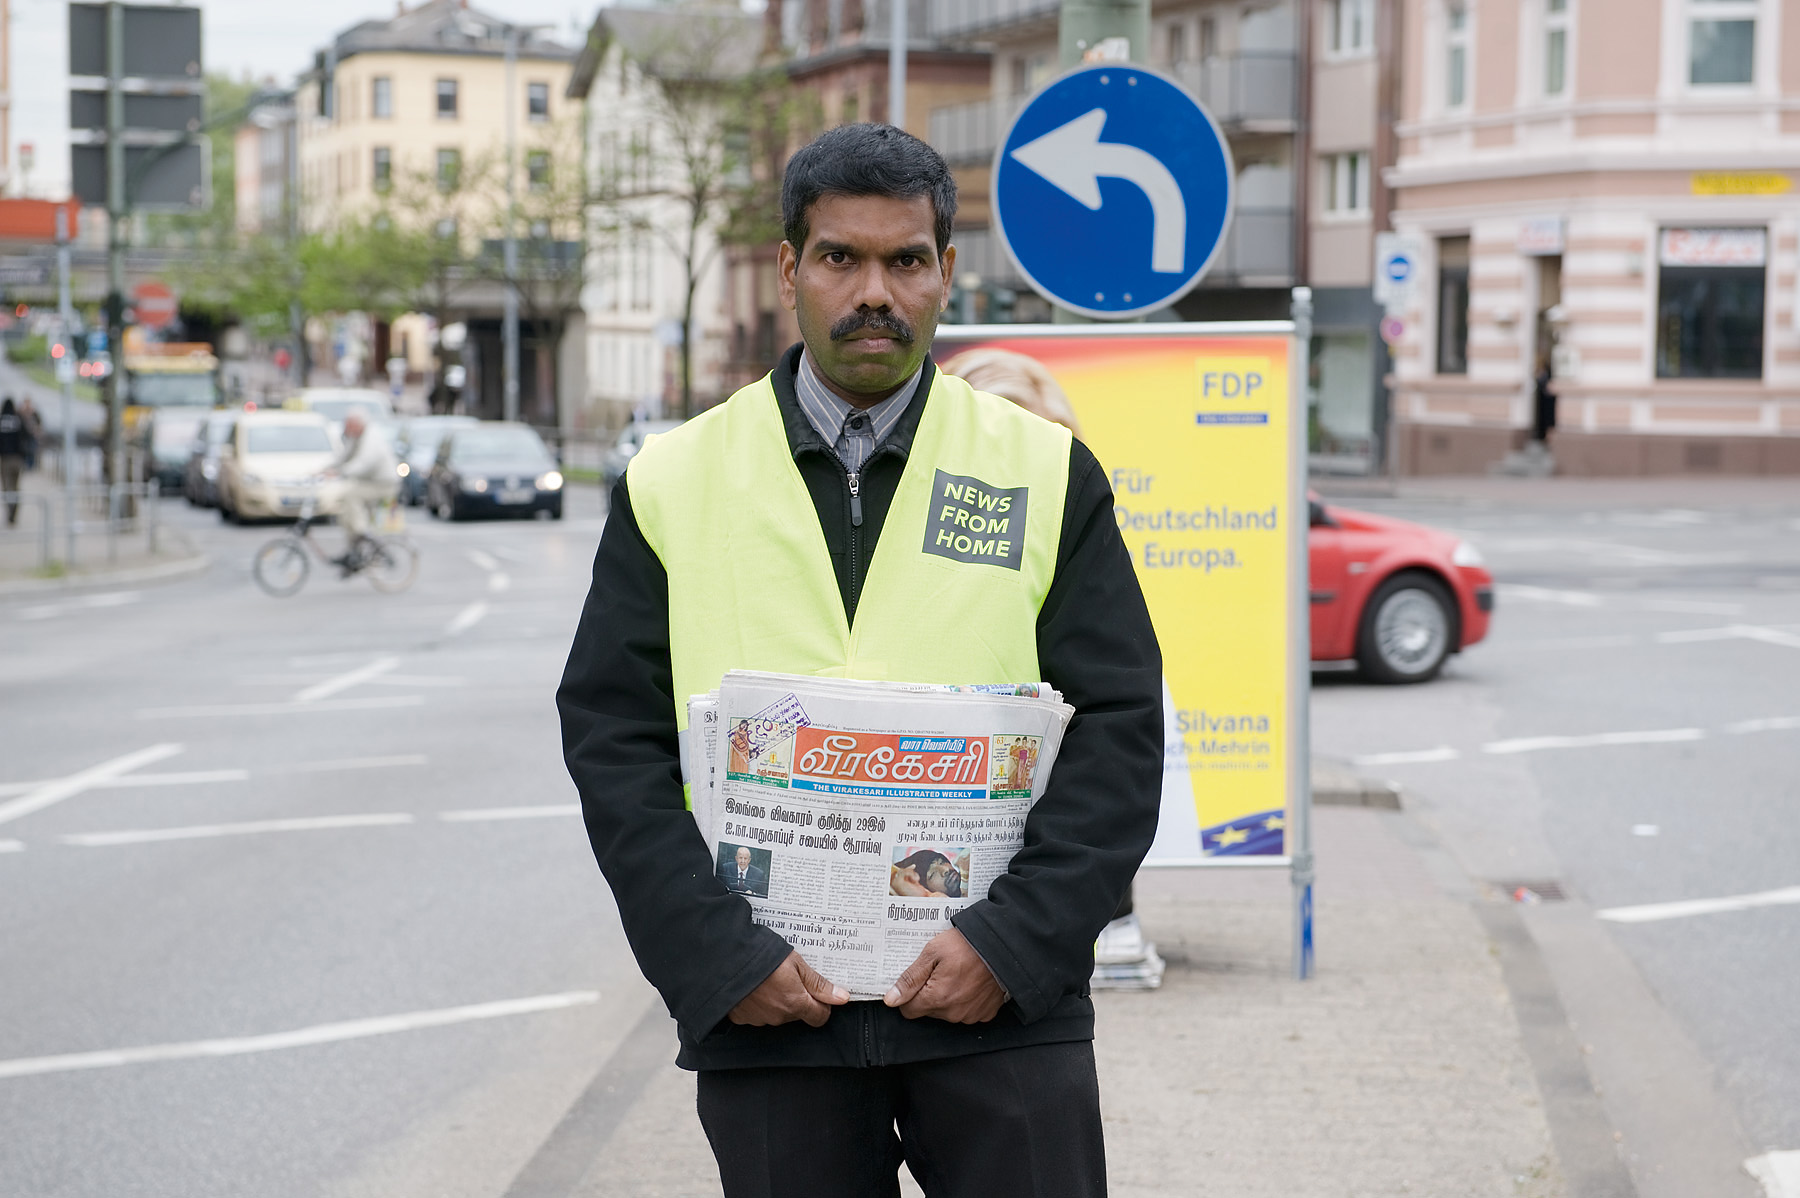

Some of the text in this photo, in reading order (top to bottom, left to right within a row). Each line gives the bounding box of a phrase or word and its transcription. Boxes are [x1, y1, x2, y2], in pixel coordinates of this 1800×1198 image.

[1203, 371, 1264, 398] FDP
[1112, 468, 1155, 494] Für
[943, 482, 1012, 513] NEWS
[939, 504, 1010, 534] FROM
[1114, 505, 1278, 531] Deutschland
[935, 528, 1011, 558] HOME
[1144, 542, 1243, 574] Europa.
[1175, 709, 1270, 734] Silvana
[800, 735, 985, 783] வீரகேசரி
[901, 741, 921, 751] வார
[813, 784, 830, 792] THE
[833, 786, 883, 796] VIRAKESARI
[886, 789, 940, 798] ILLUSTRATED
[725, 798, 886, 833] இலங்கை விவகாரம் குறித்து 29இல்
[799, 833, 839, 852] சபையில்
[843, 837, 882, 856] ஆராய்வு
[887, 902, 940, 922] நிரந்தரமான
